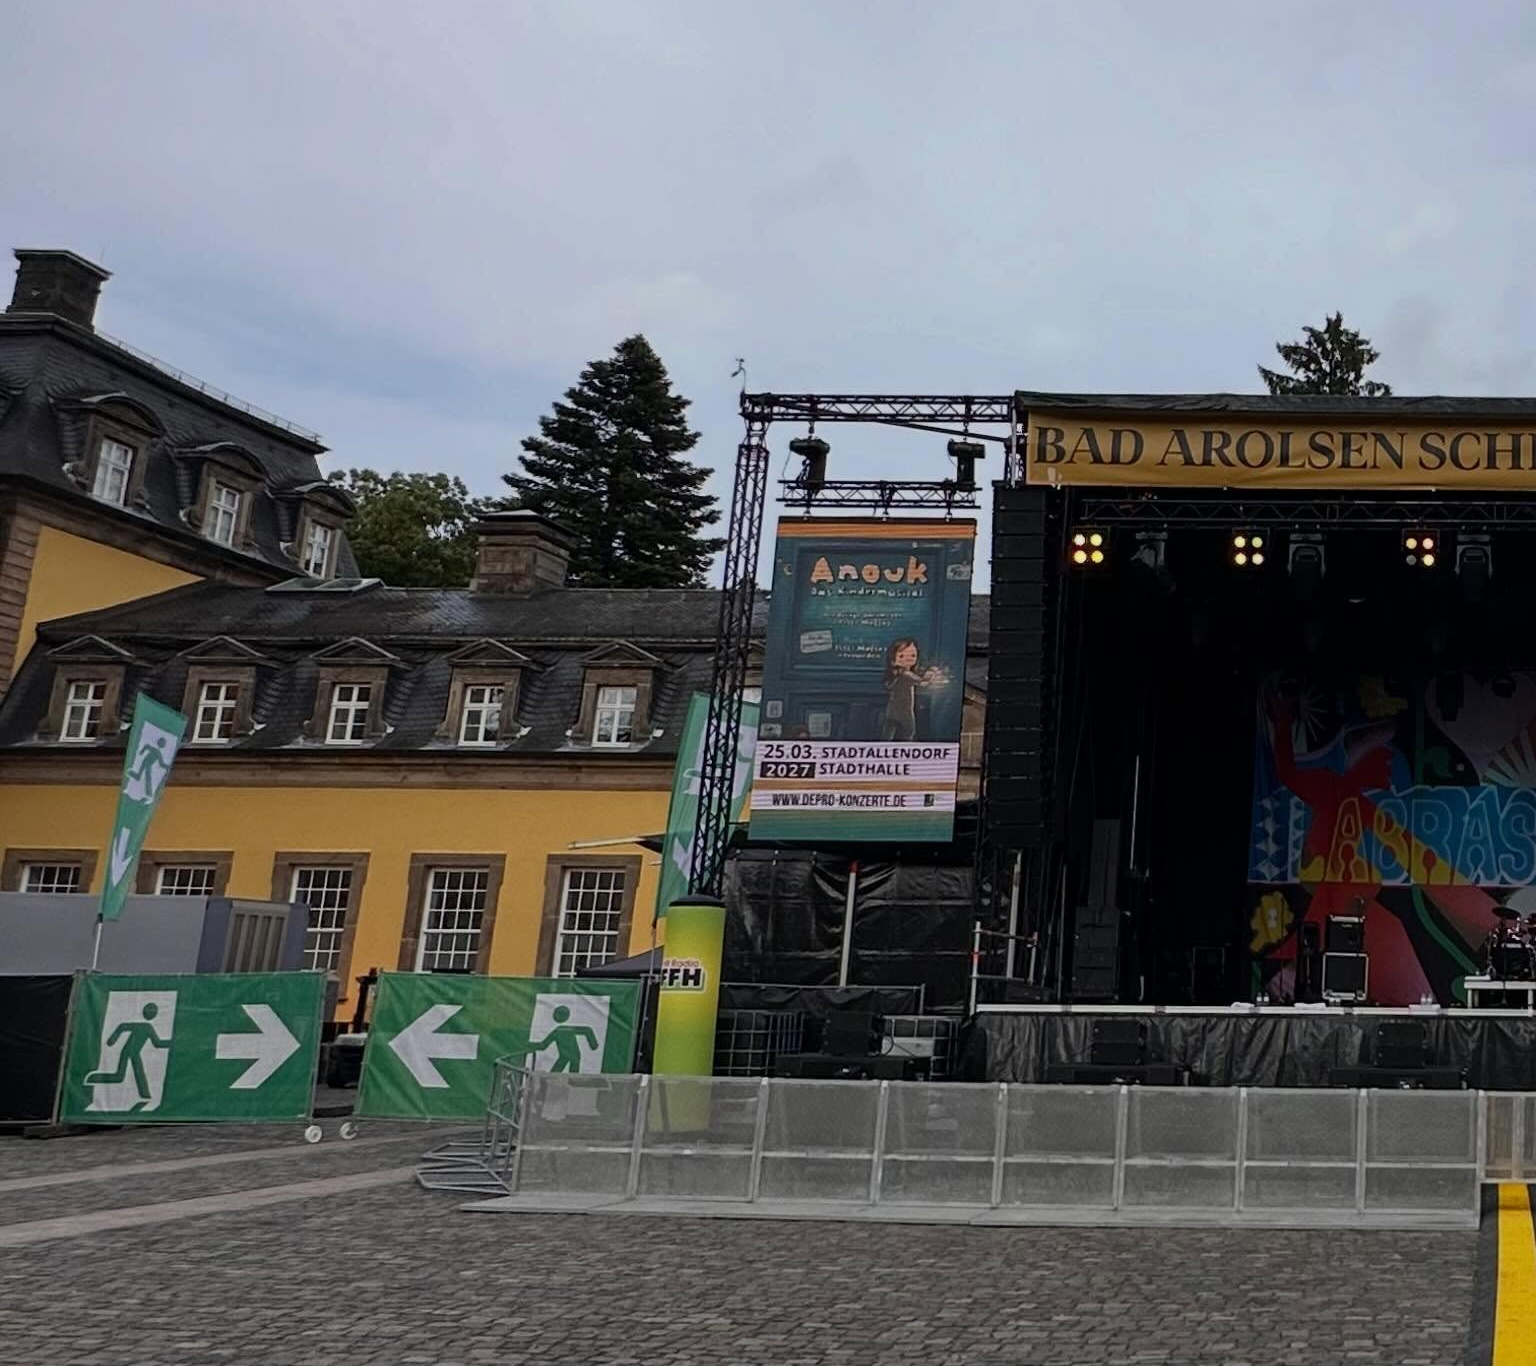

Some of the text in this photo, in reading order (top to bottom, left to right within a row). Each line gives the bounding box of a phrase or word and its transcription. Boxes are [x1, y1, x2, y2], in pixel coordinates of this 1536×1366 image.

[1033, 425, 1144, 466] BAD
[1155, 427, 1408, 471] AROLSEN
[809, 554, 929, 585] Anouk
[763, 744, 950, 760] 25.03. STADTALLENDORF
[765, 762, 911, 777] 2027 STADTHALLE
[771, 792, 907, 808] WWW.DEPRO-KONZERTE.DE
